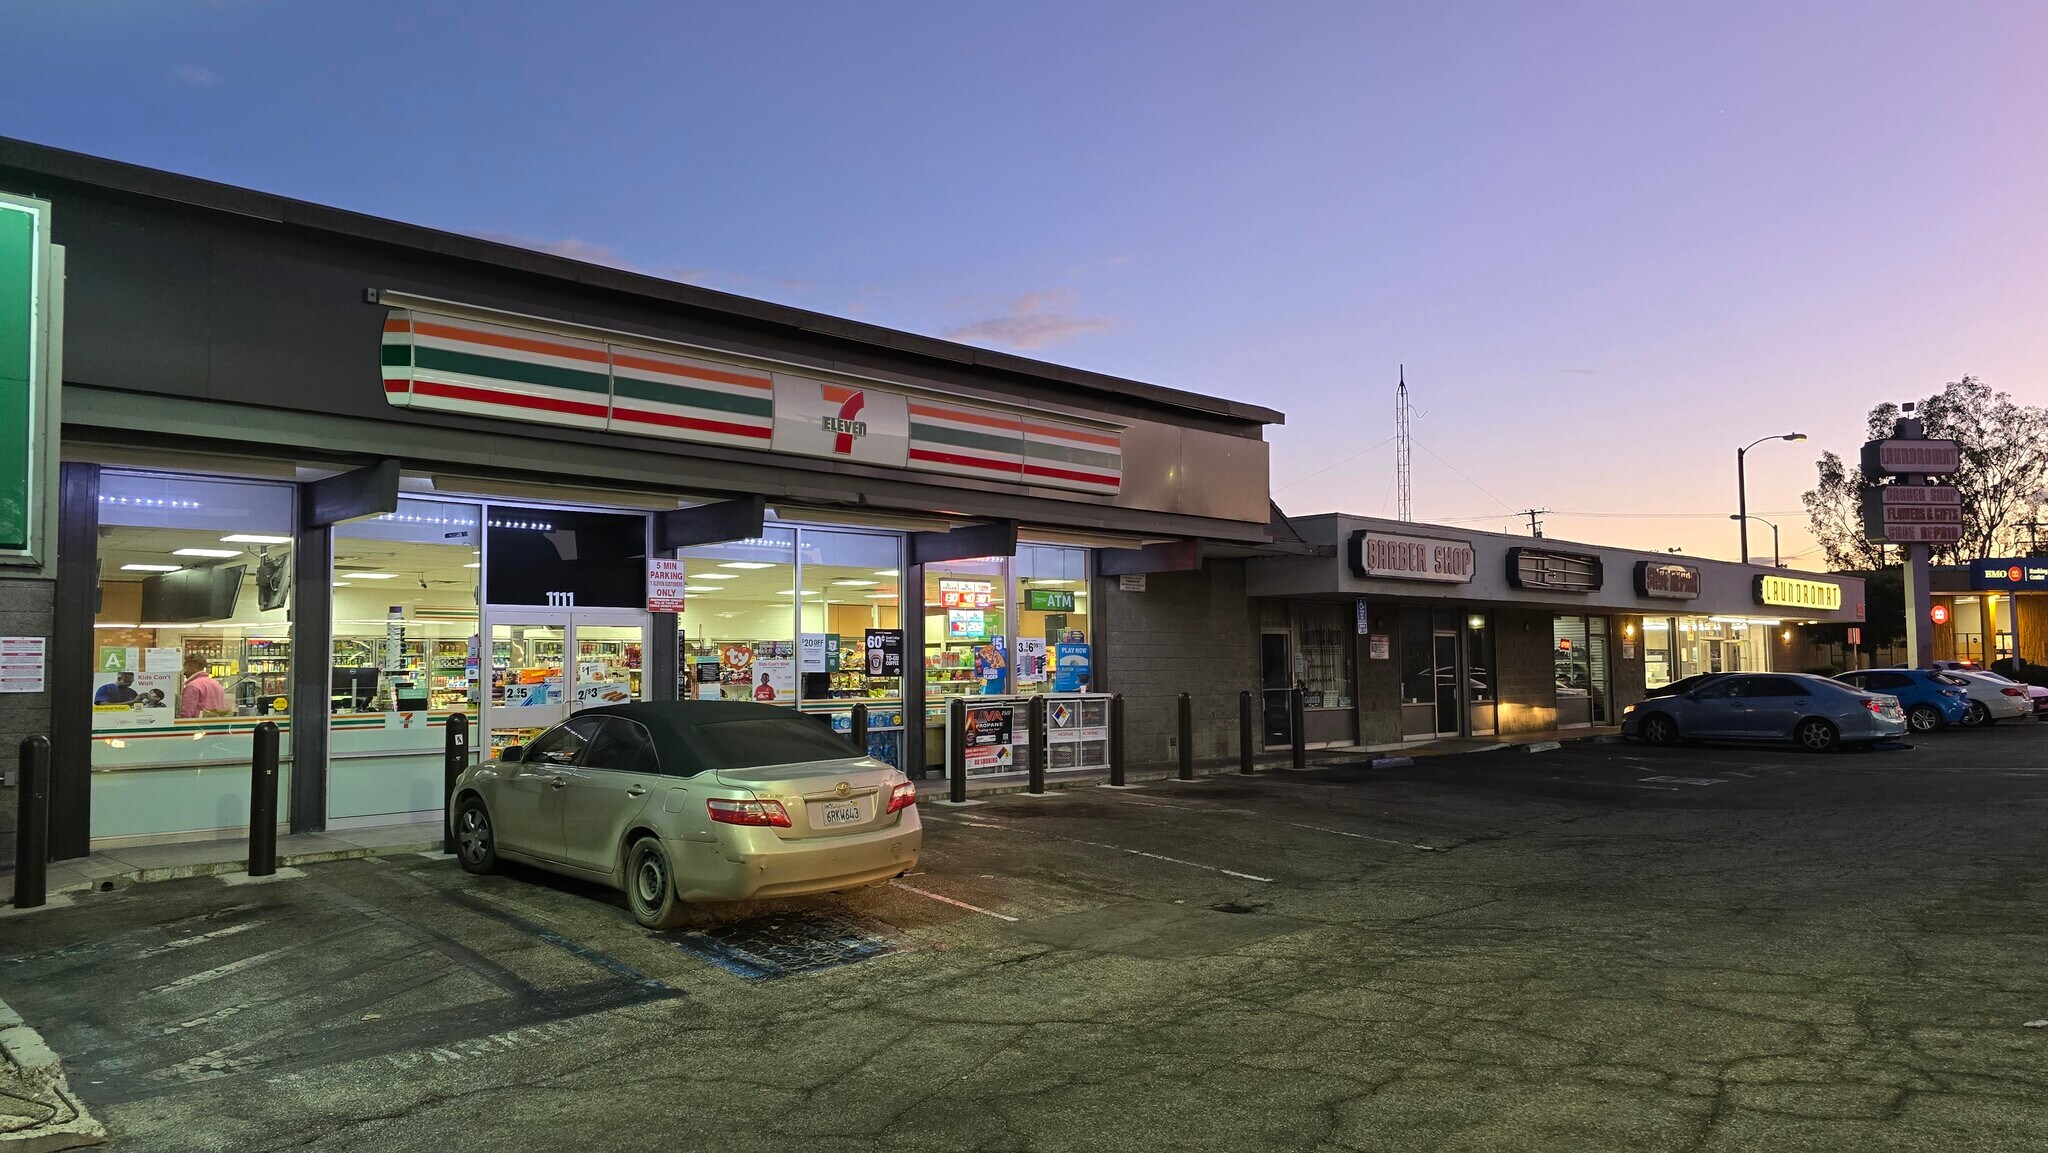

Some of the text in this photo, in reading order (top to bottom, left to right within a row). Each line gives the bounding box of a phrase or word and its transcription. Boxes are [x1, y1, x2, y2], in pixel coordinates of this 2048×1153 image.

[821, 384, 865, 455] 7
[1880, 447, 1957, 465] LAUNDROMAT
[1886, 488, 1957, 502] BARBER SHOP
[1886, 507, 1926, 520] FLOWERS
[1934, 508, 1959, 520] GIFTS
[1888, 526, 1959, 540] SHOE REPAIR
[1367, 538, 1471, 575] BARBER SHOP
[664, 562, 677, 570] MIN
[650, 571, 683, 580] PARKING
[1984, 570, 2008, 578] BMO
[546, 592, 574, 607] 1111
[657, 589, 676, 597] ONLY
[1766, 580, 1837, 606] LAUNDROMAT
[1047, 595, 1072, 608] ATM
[991, 638, 1003, 651] $5
[1018, 643, 1024, 652] 3
[105, 653, 121, 668] A
[726, 648, 749, 666] ty
[582, 666, 590, 675] $1
[507, 688, 514, 698] 2
[517, 688, 528, 698] $5
[980, 757, 998, 765] SMOKING
[827, 807, 859, 823] 6RKW643
